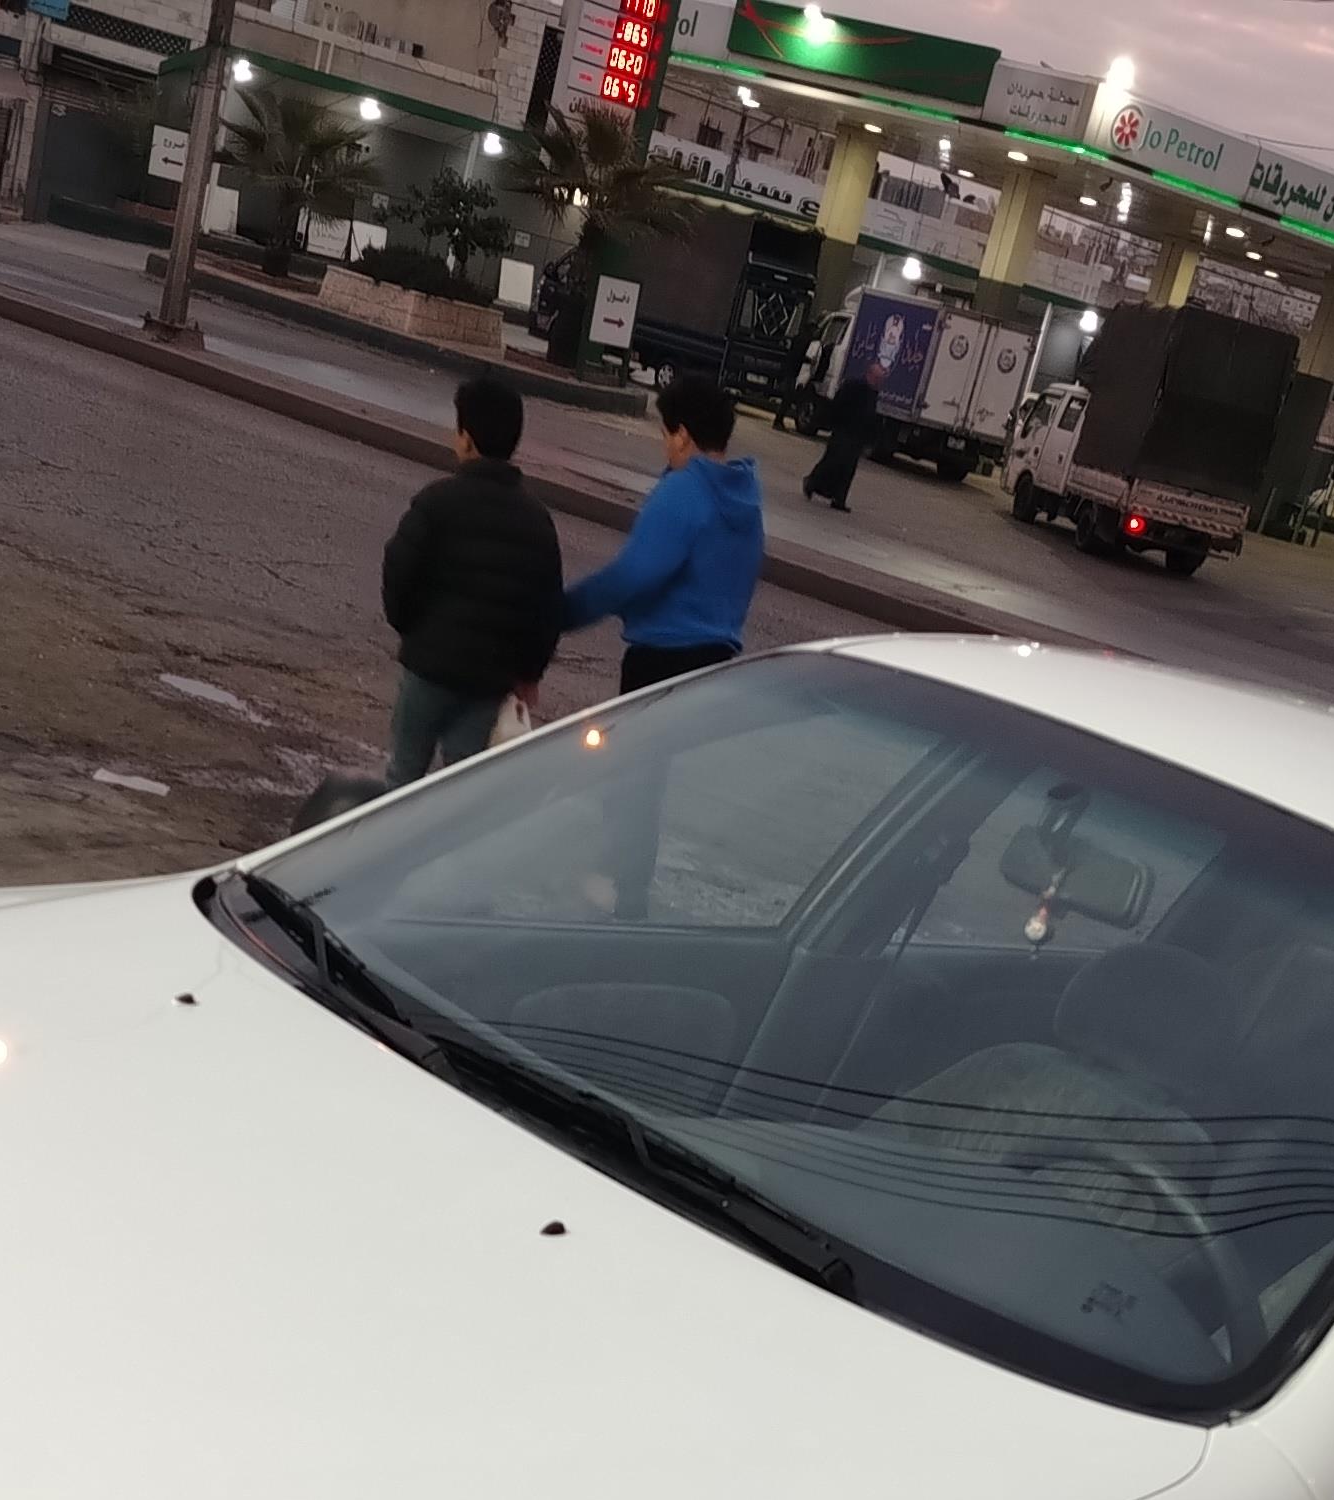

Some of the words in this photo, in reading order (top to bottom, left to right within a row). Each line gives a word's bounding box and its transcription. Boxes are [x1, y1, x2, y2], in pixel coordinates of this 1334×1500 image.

[609, 47, 643, 75] 0620
[1138, 120, 1162, 150] Jo
[1164, 128, 1224, 172] Petrol
[1249, 158, 1327, 212] للمحروقات
